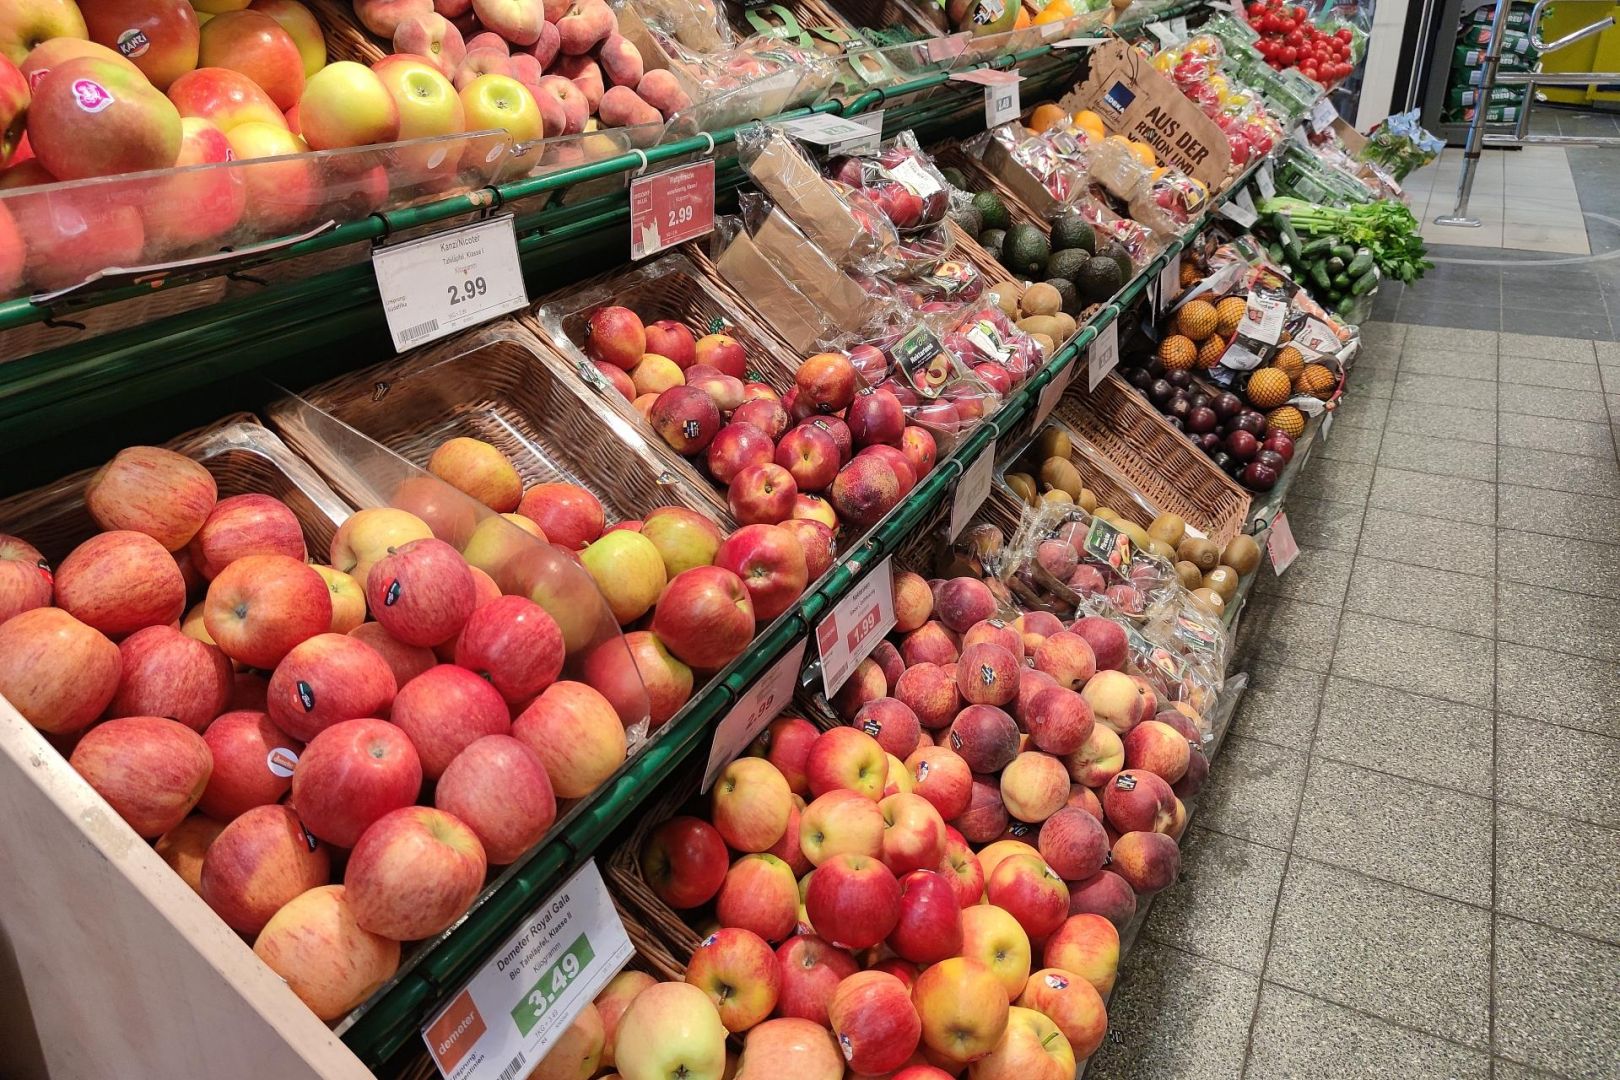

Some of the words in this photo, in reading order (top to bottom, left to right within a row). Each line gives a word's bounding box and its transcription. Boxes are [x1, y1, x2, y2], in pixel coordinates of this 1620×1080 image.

[120, 31, 147, 54] KANZI
[1104, 93, 1125, 114] EDEKA
[1134, 120, 1174, 157] REION
[1170, 152, 1195, 176] UND
[1145, 106, 1181, 138] AUS
[1175, 131, 1210, 165] DER
[668, 205, 693, 227] 2.99
[447, 276, 487, 305] 2.99
[853, 612, 875, 643] 1.99
[745, 694, 775, 730] 2.99
[496, 935, 530, 972] Demeter
[529, 910, 553, 937] Royal
[552, 894, 570, 914] Gala
[509, 967, 521, 981] Bio
[548, 917, 568, 938] Klasse
[532, 942, 562, 973] Kilogramm
[528, 952, 580, 1017] 3.49
[438, 1010, 475, 1056] demeter
